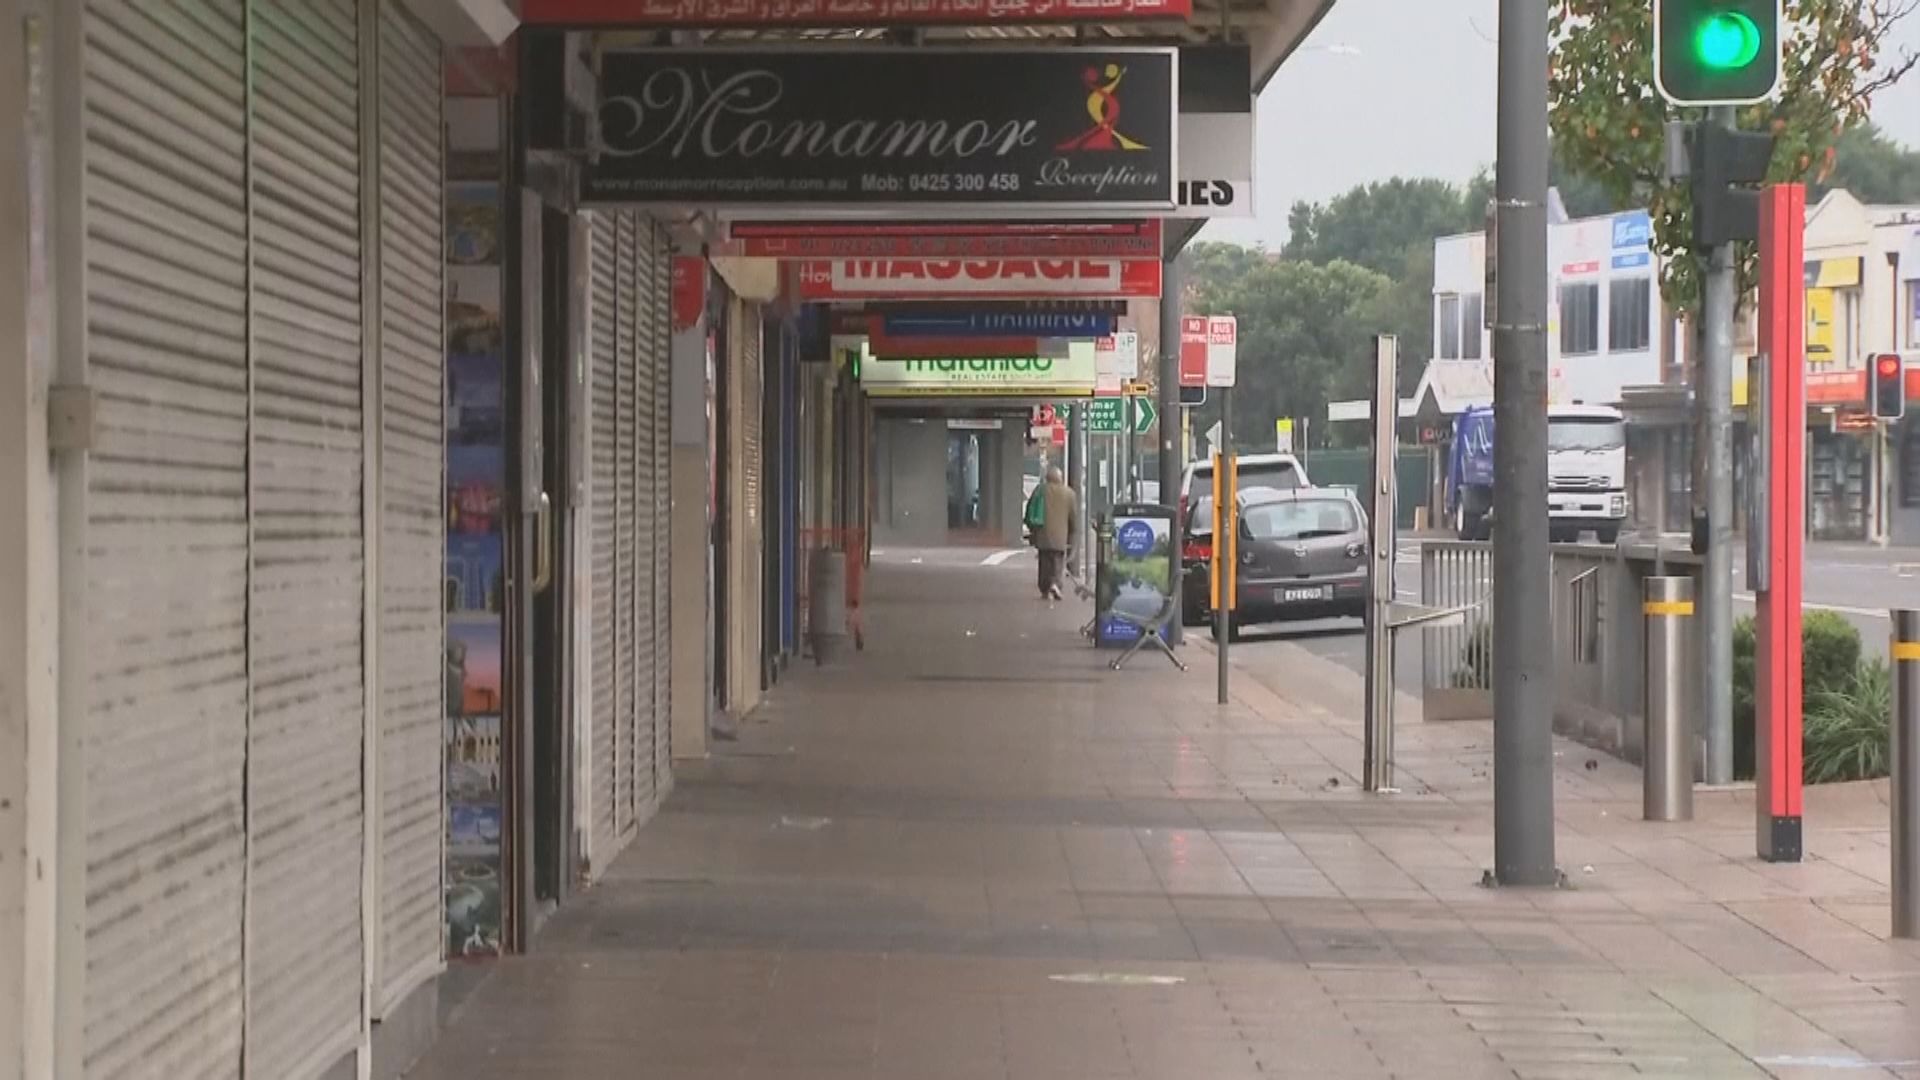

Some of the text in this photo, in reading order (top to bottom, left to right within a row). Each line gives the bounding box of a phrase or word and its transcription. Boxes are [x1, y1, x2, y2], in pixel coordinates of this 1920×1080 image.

[598, 65, 1036, 160] Monamor
[861, 173, 1020, 191] Mob: 0425 300 458
[1034, 158, 1158, 194] Reception
[1189, 320, 1201, 332] NO
[1213, 323, 1231, 334] BUS
